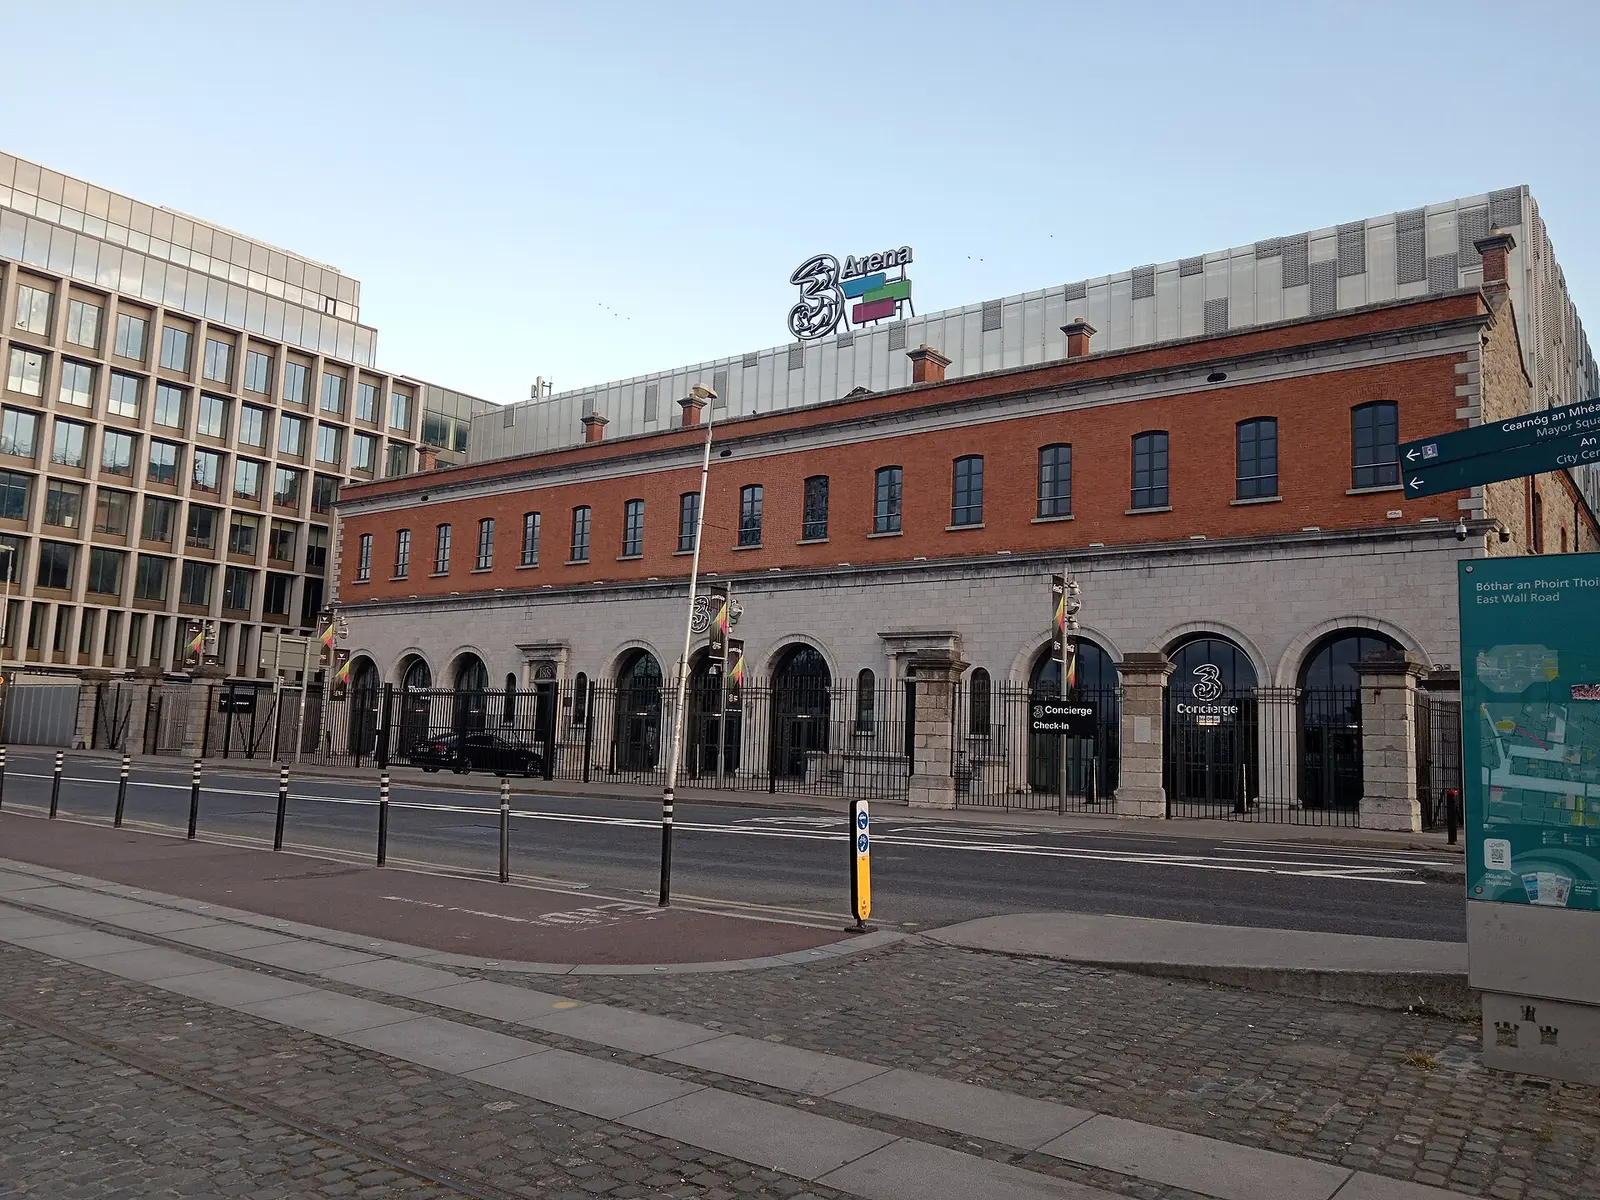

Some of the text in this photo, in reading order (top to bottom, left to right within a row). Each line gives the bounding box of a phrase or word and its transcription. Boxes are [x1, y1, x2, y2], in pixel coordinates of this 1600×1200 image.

[787, 245, 913, 340] 3 Arena
[1502, 414, 1549, 432] Cearnóg
[1551, 412, 1566, 421] an
[1536, 423, 1572, 438] Mayor
[1580, 437, 1597, 447] An
[1556, 454, 1578, 465] City
[1476, 577, 1600, 591] Bóthar an Phoirt Thoi
[1476, 592, 1560, 604] East Wall Road
[1192, 663, 1223, 702] 3
[1045, 705, 1093, 717] Concierge
[1176, 703, 1239, 716] Concierge
[1033, 721, 1070, 730] Check-In
